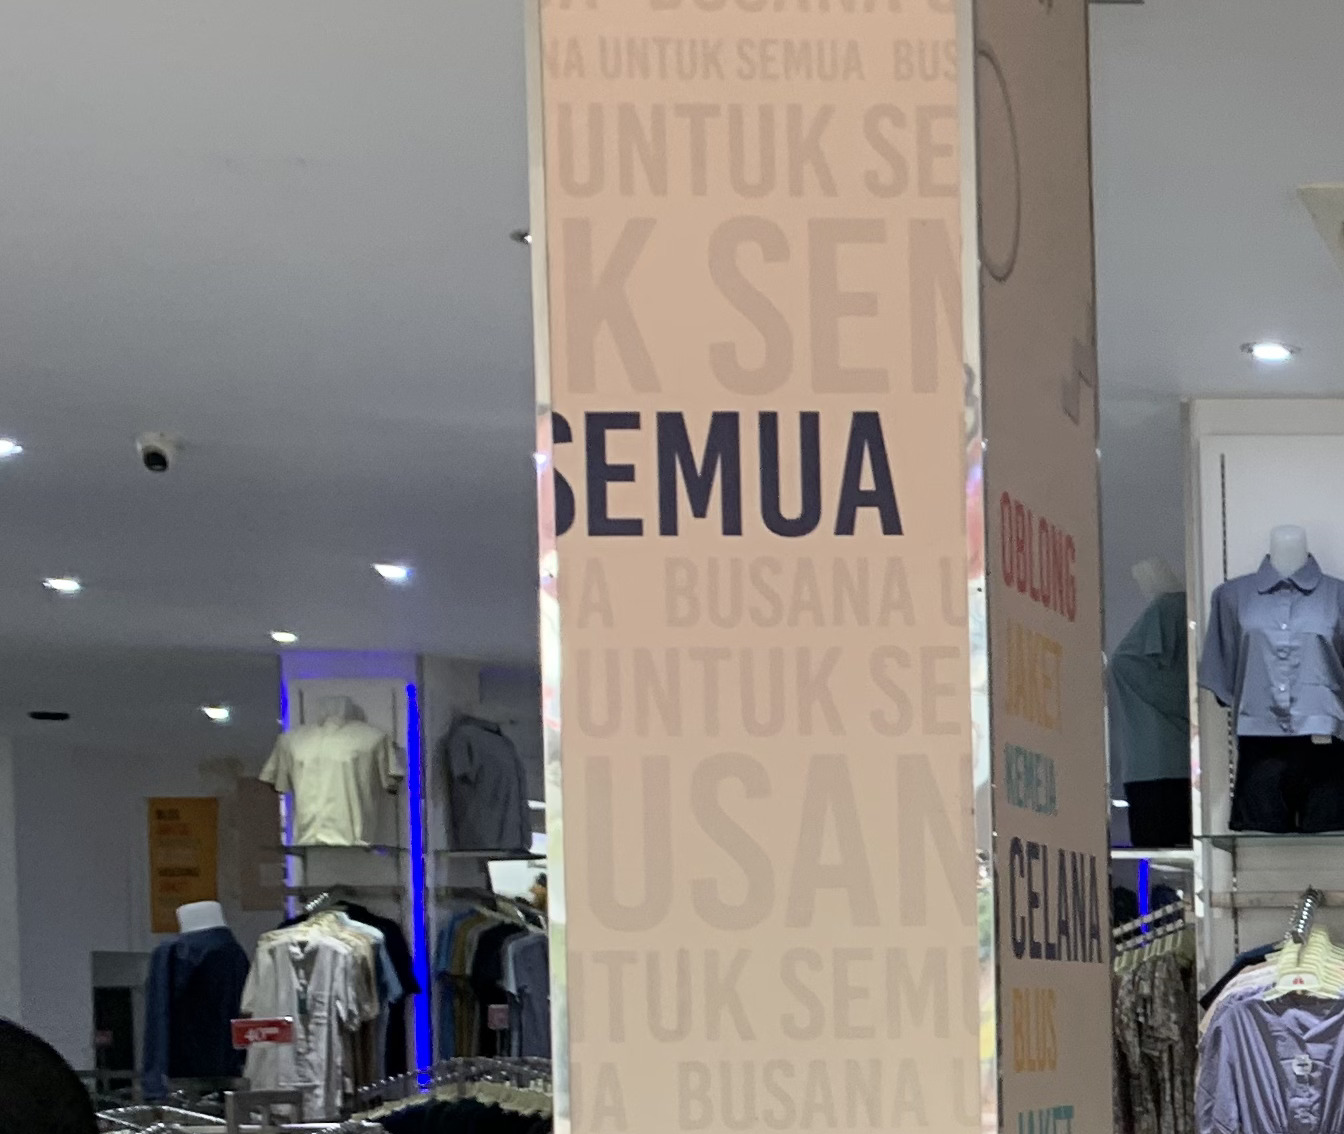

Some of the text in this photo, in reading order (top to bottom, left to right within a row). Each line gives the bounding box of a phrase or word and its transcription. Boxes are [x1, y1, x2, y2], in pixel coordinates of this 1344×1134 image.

[600, 37, 723, 79] UNTUK
[735, 39, 864, 81] SEMUA
[557, 103, 958, 199] UNTUK SE
[562, 217, 662, 394] K
[664, 556, 916, 629] BUSANA
[1001, 490, 1076, 622] OBLONG
[576, 645, 963, 739] UNTUK SE
[1009, 836, 1104, 963] CELANA
[677, 1059, 929, 1131] BUSANA
